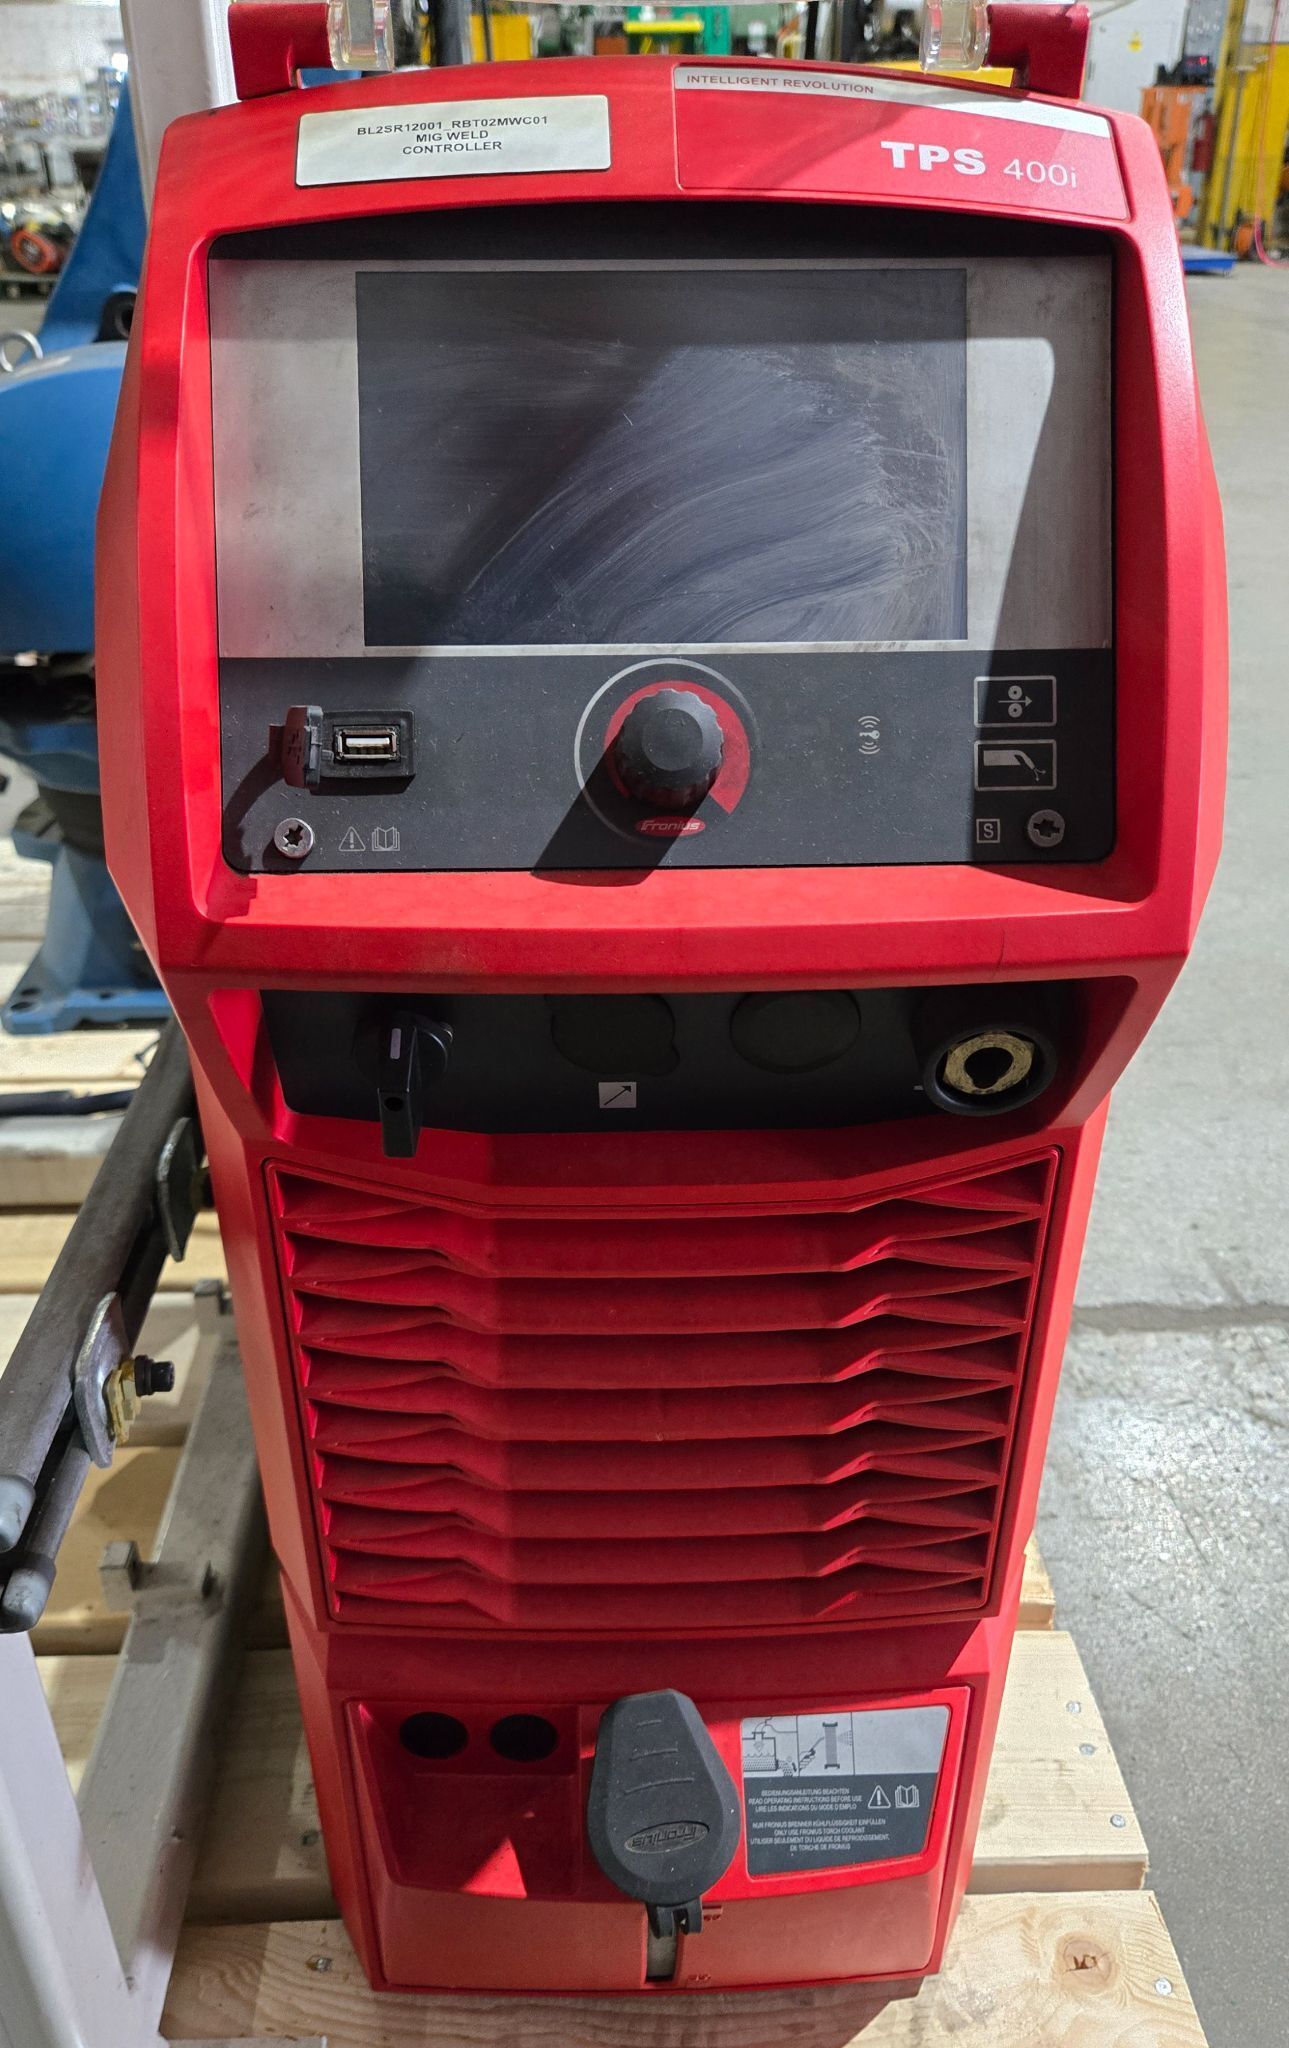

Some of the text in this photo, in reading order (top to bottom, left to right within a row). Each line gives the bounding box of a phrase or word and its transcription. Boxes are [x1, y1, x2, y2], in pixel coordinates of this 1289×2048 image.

[687, 75, 874, 94] INTELLIGENT REVOLUTION
[416, 130, 489, 143] MIG WELD
[402, 141, 502, 155] CONTROLLER
[880, 141, 1077, 188] TPS 400i
